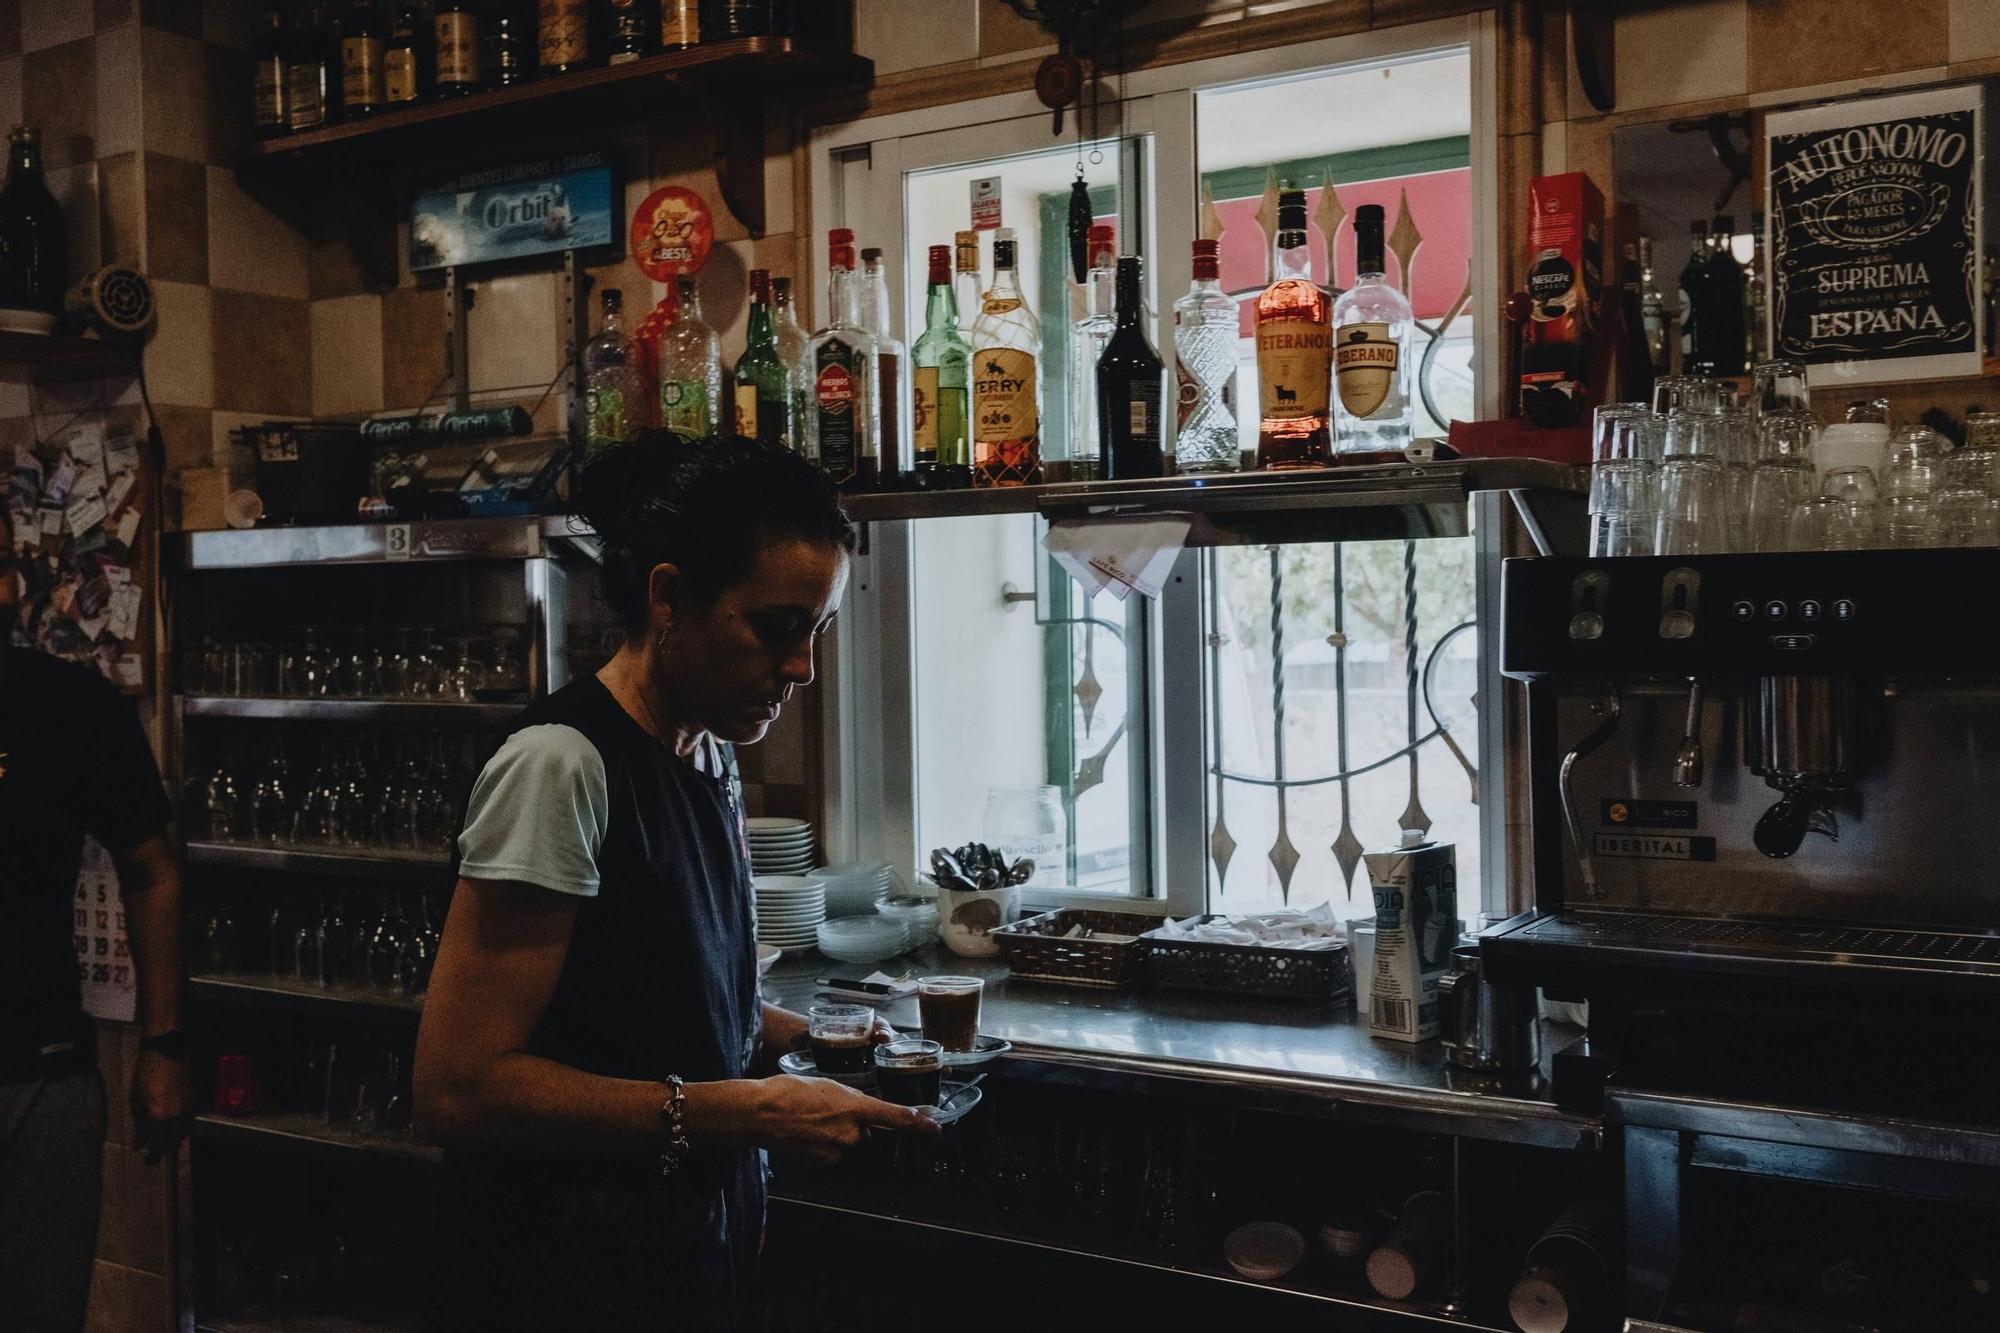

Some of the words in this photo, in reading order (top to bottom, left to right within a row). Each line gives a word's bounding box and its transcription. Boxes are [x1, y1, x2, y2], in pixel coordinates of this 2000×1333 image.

[1782, 122, 1967, 193] AUTONOMO
[484, 191, 552, 230] Orbit
[1863, 203, 1905, 218] MESES
[1816, 261, 1931, 294] SUPREMA
[1808, 299, 1948, 339] ESPAÑA
[390, 527, 407, 552] 3
[1601, 838, 1686, 855] IBERITAL
[75, 909, 88, 928] 11
[95, 910, 109, 930] 12
[95, 936, 109, 956] 19
[93, 962, 109, 983] 26
